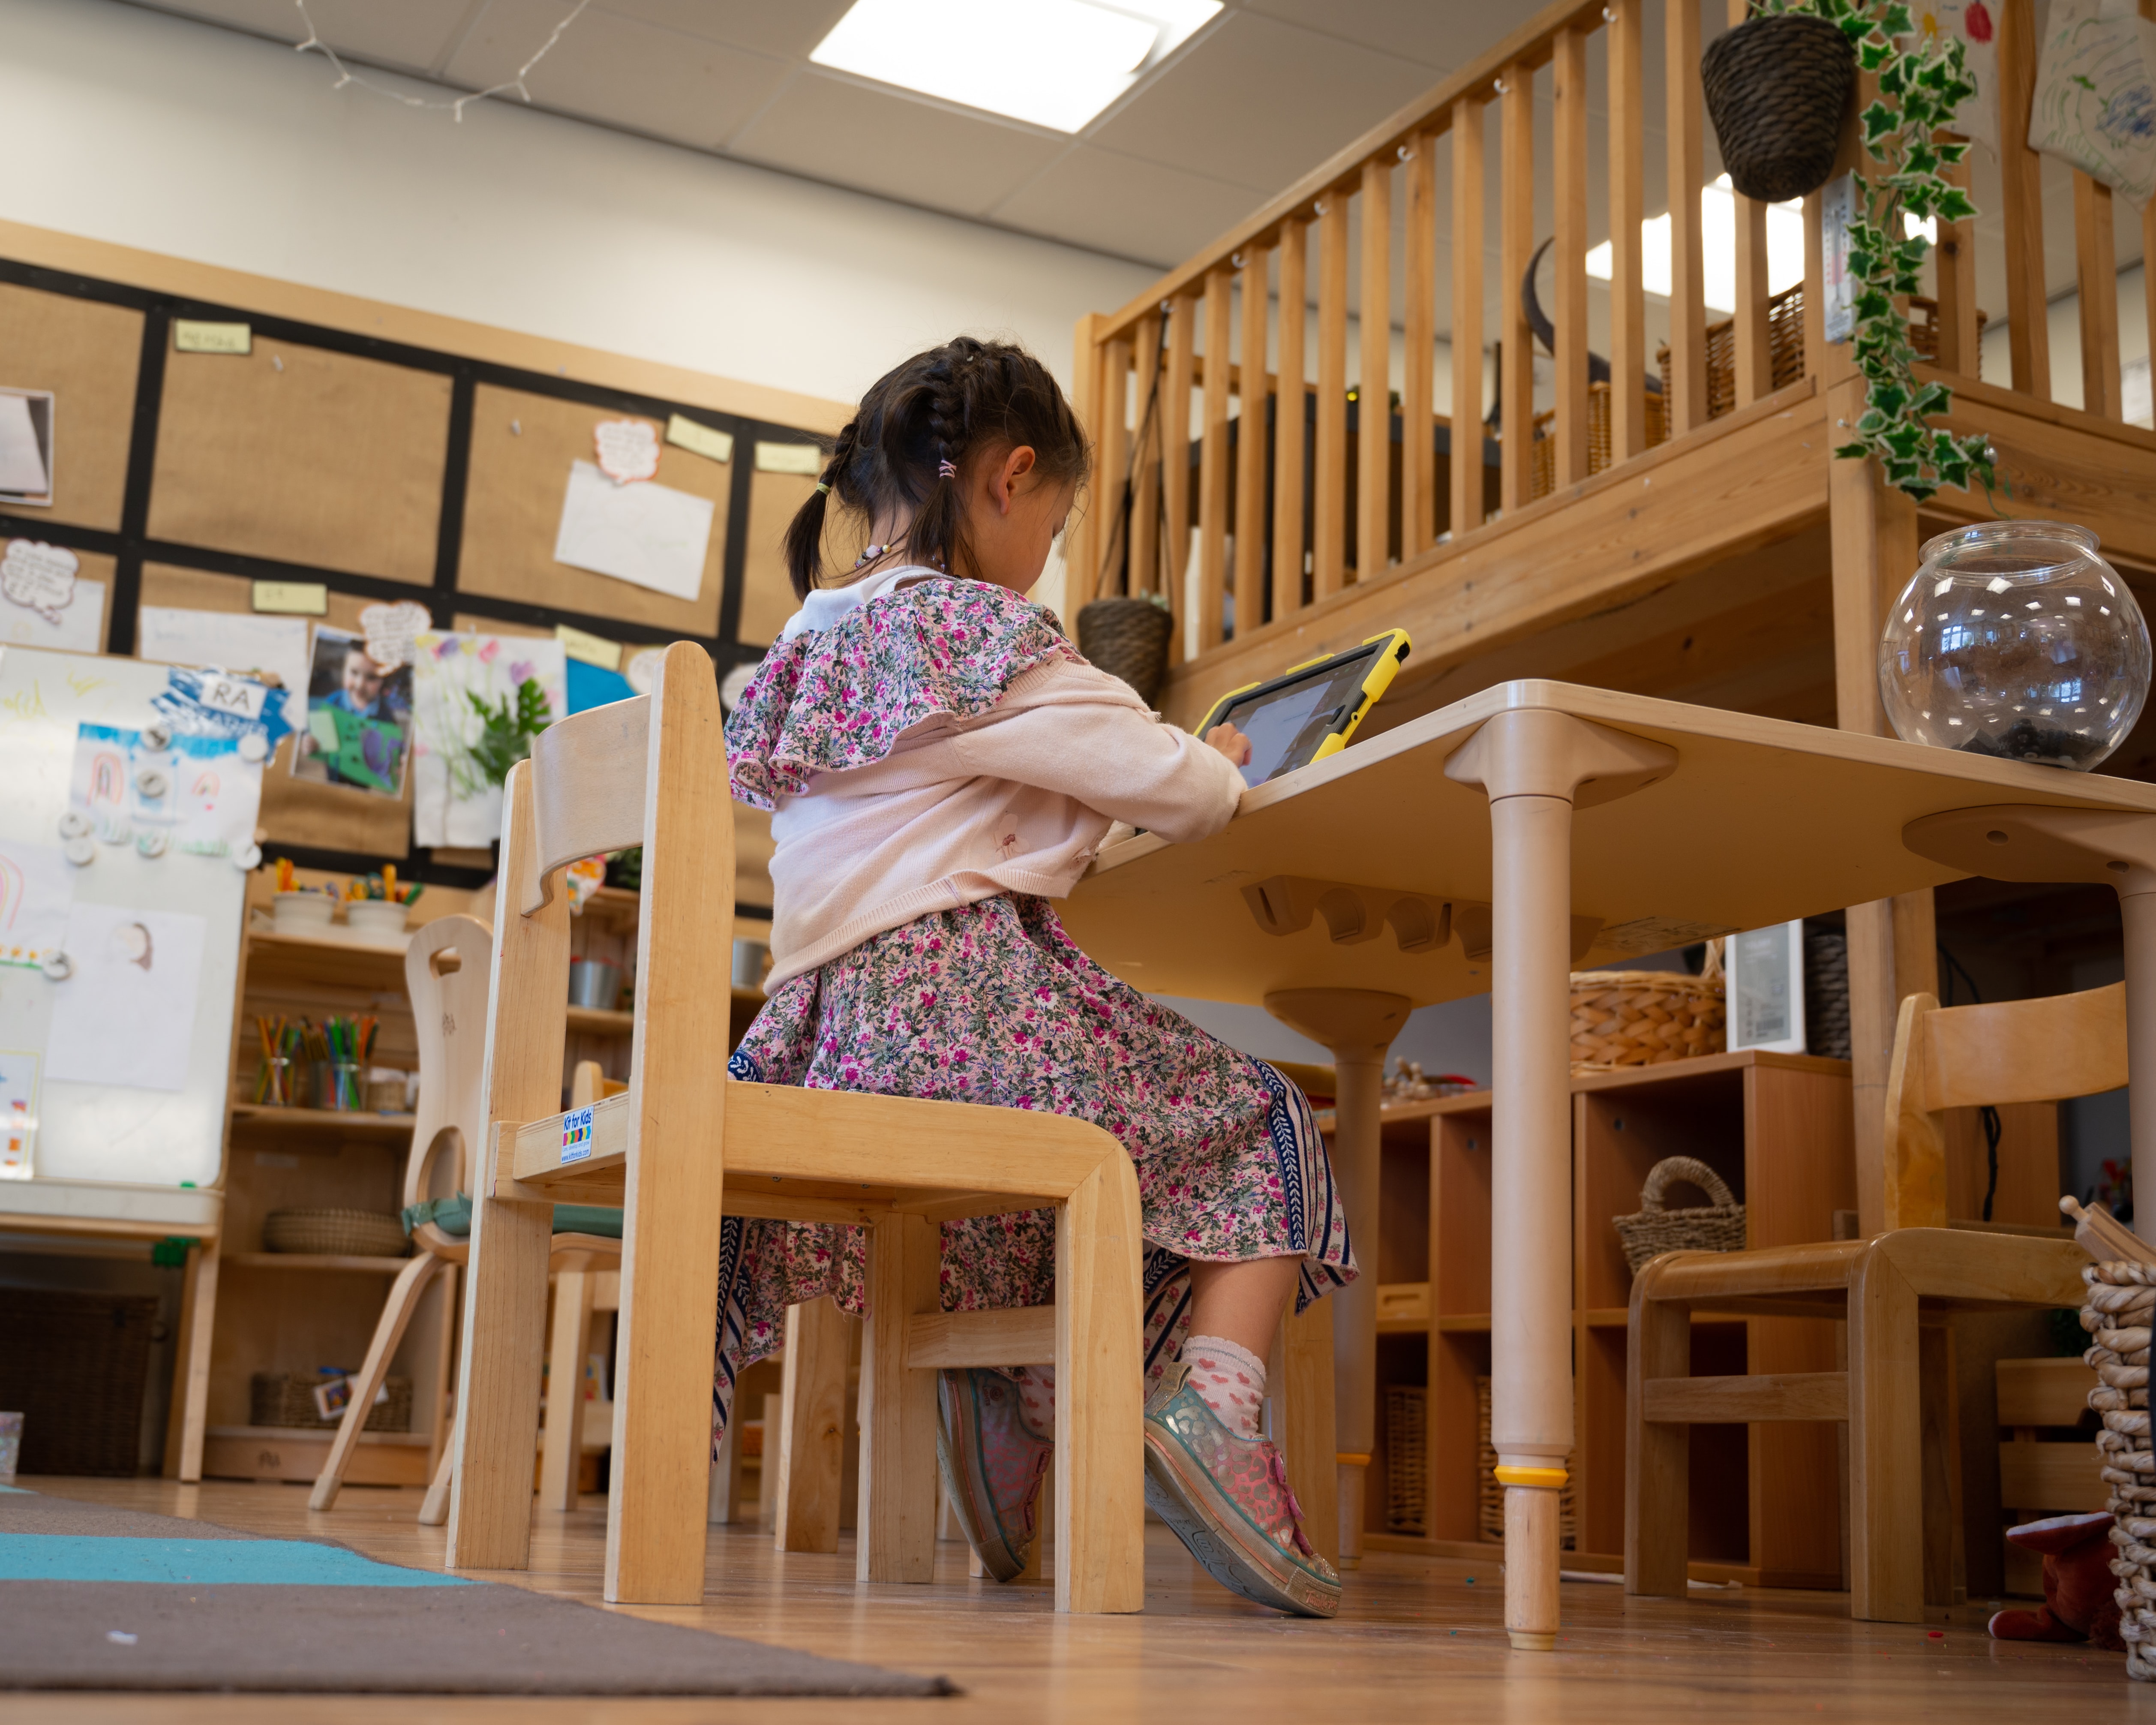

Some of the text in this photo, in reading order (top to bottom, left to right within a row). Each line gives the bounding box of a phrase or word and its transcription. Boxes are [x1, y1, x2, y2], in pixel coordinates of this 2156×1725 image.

[214, 682, 250, 711] RA
[580, 1109, 592, 1126] Kids
[562, 1149, 589, 1162] www.kitforkids.com
[1306, 1589, 1328, 1611] Twinkle
